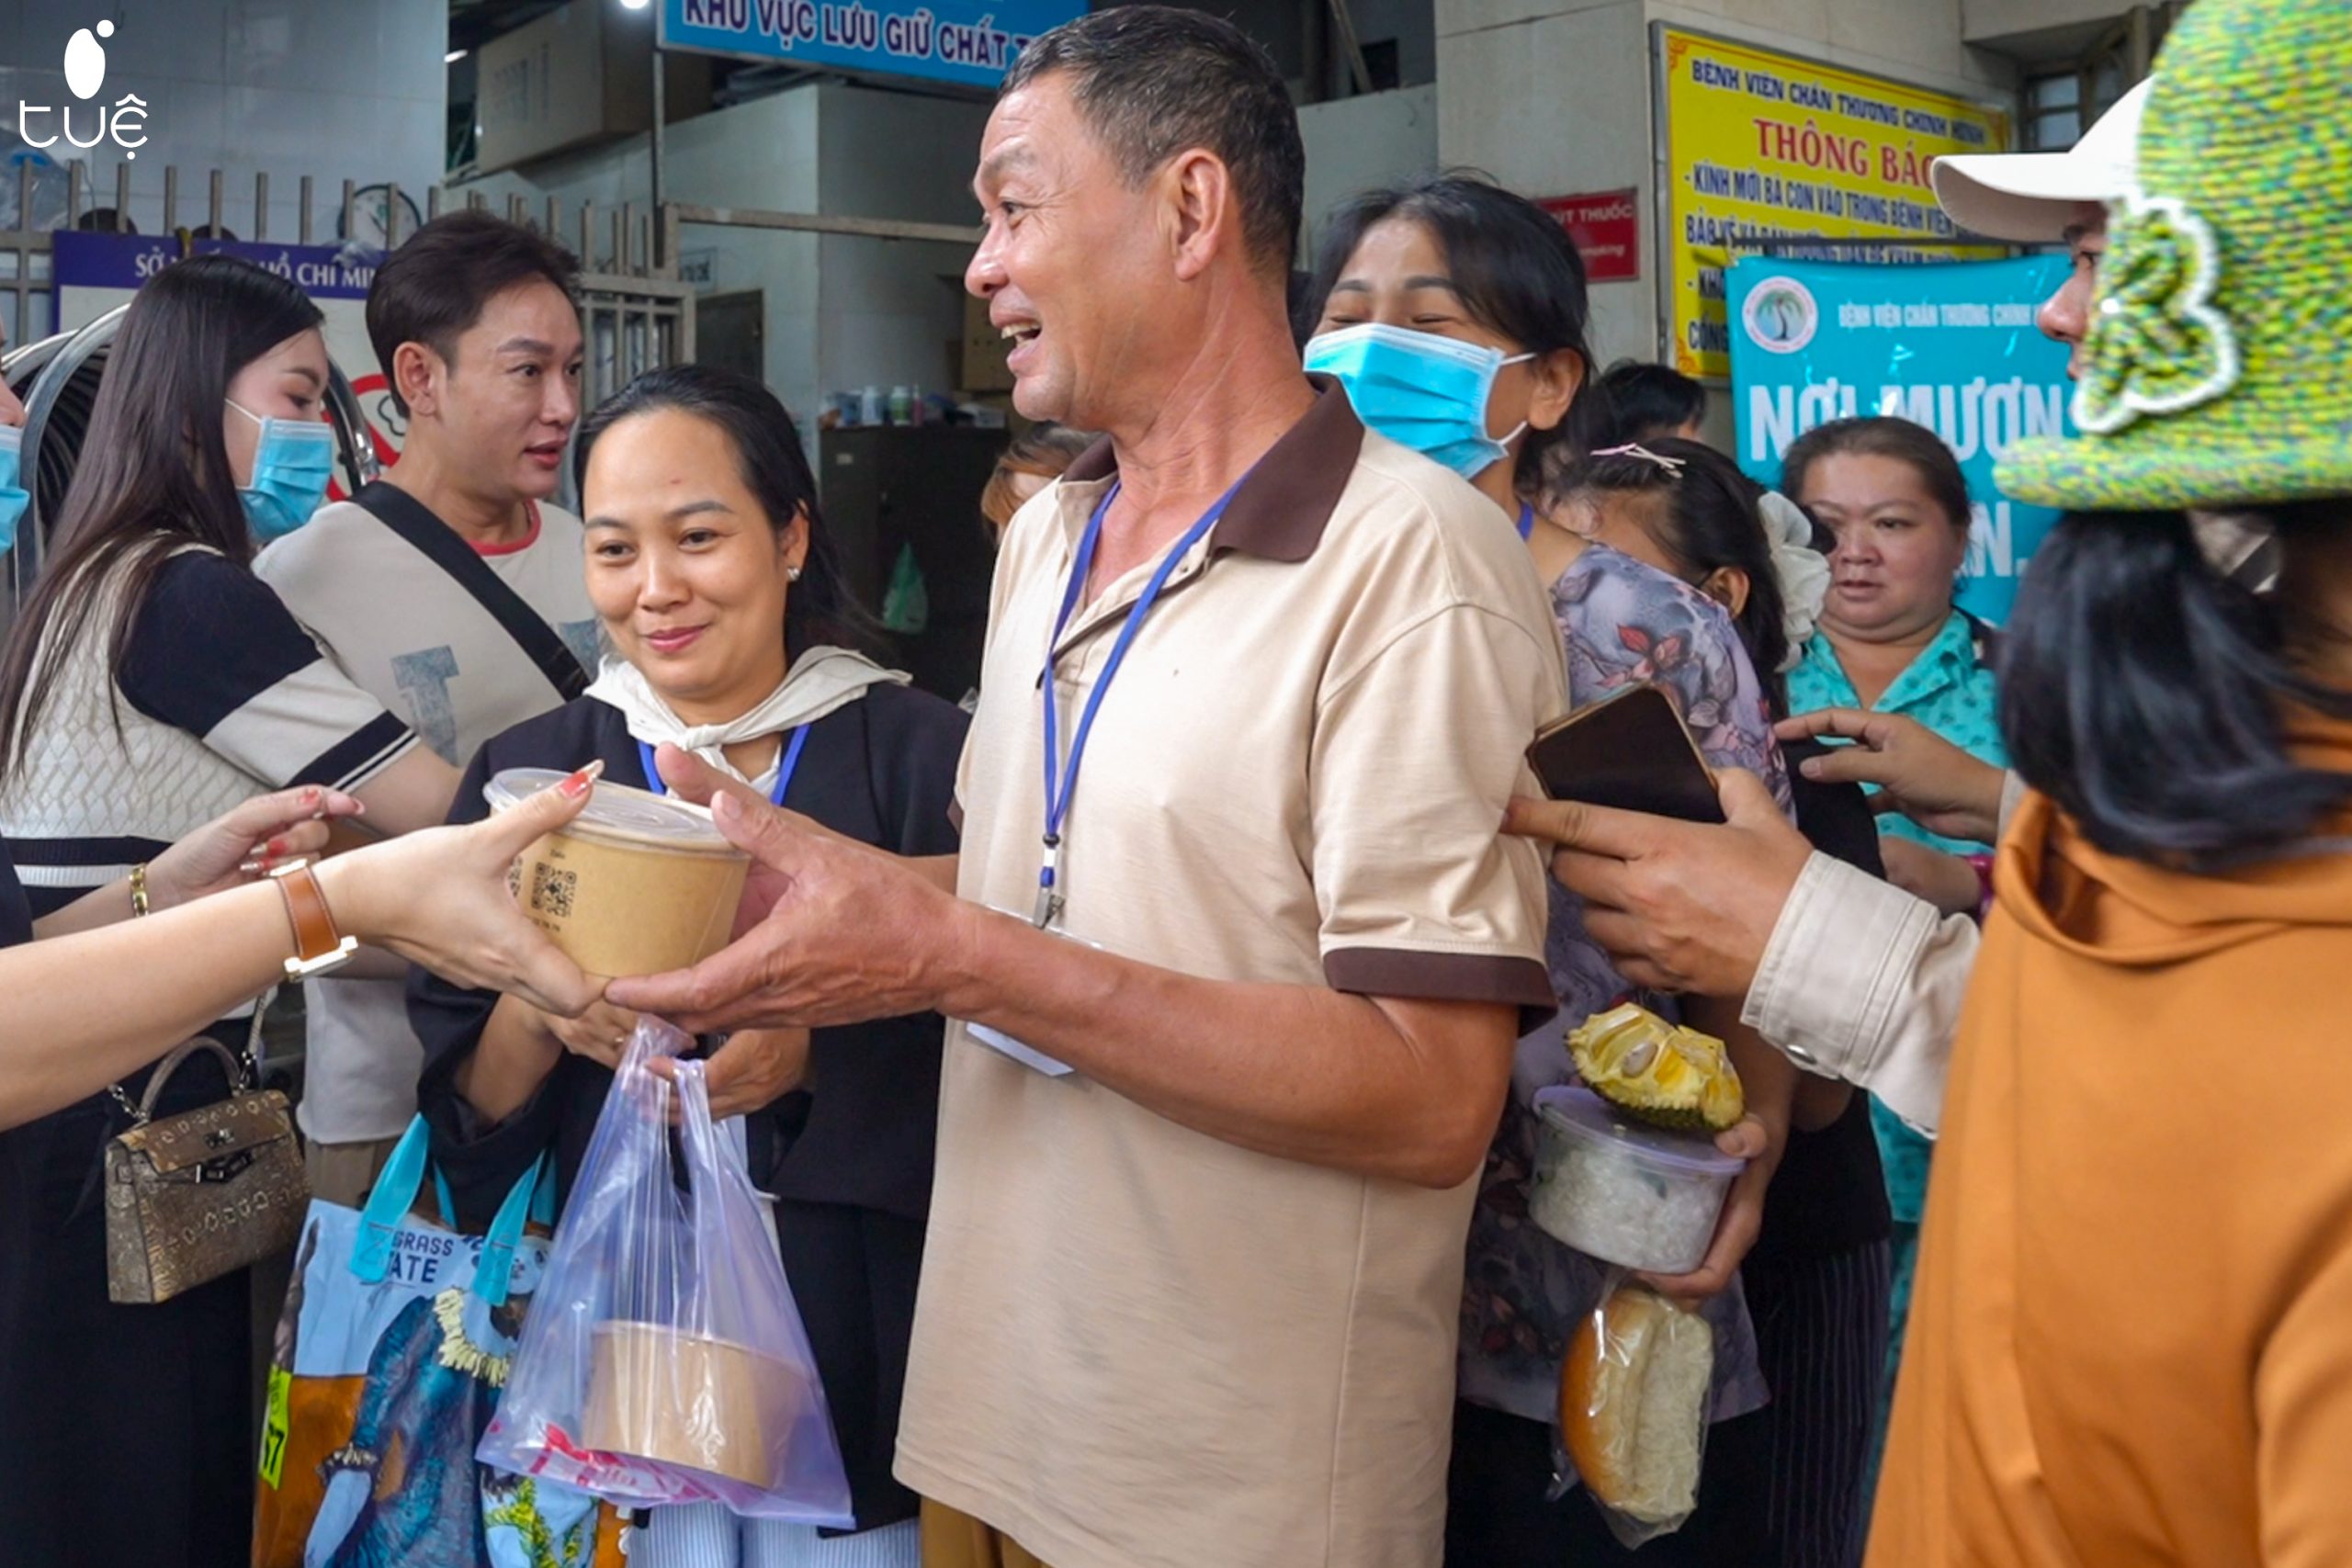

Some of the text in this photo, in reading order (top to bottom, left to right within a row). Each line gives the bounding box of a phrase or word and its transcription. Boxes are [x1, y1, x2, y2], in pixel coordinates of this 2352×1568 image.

[685, 0, 1007, 67] KHU VỰC LƯU GIỮ CHẤT
[1691, 57, 1739, 90] BỆNH
[1753, 118, 1868, 176] THÔNG
